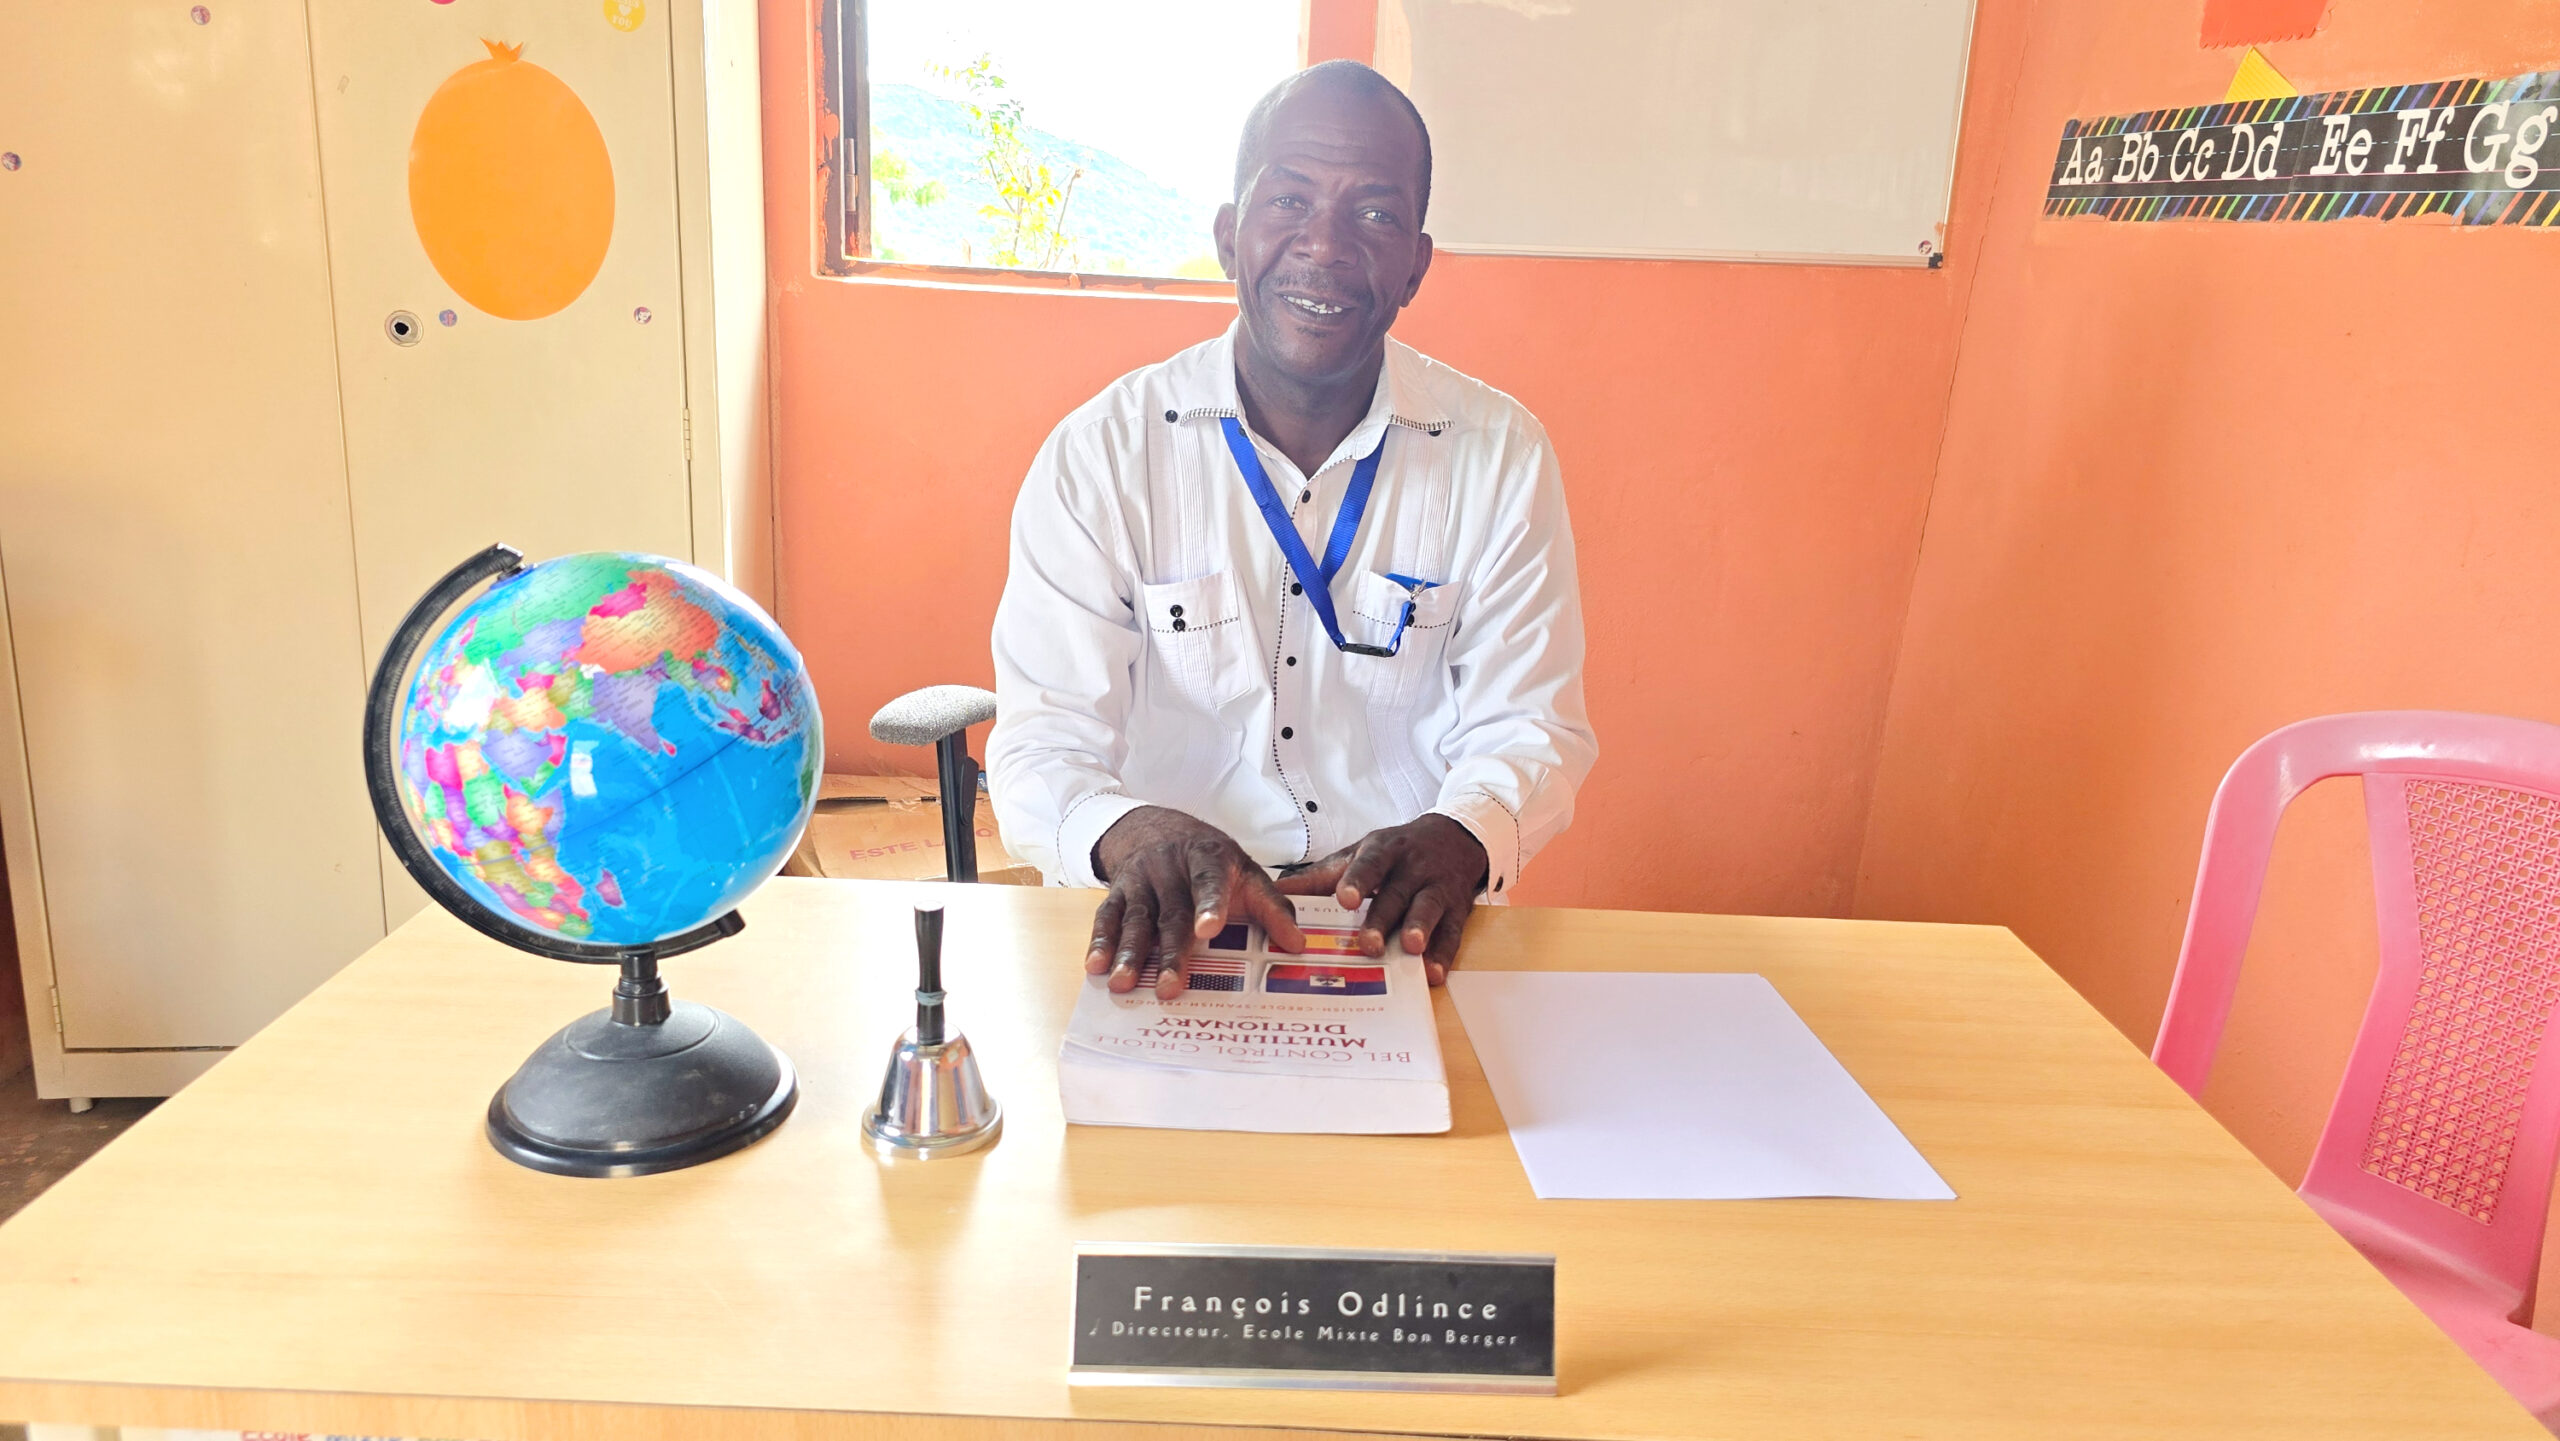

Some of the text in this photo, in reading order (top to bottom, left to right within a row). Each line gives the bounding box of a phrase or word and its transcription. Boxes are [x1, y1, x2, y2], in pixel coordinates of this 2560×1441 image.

[2059, 100, 2558, 189] Aa Bb Cc Dd Ee Ff Gg
[850, 828, 994, 860] ESTE LO
[1156, 1017, 1347, 1035] DICTIONARY
[1137, 1028, 1367, 1048] MULTILINGUAL
[1211, 1045, 1353, 1062] CONTROL
[1363, 1051, 1411, 1063] BEL
[1133, 1286, 1498, 1320] François Odlince
[1242, 1324, 1305, 1340] Ecole
[1317, 1325, 1380, 1342] Mixte
[1392, 1327, 1432, 1343] Bon
[1446, 1329, 1518, 1348] Berger
